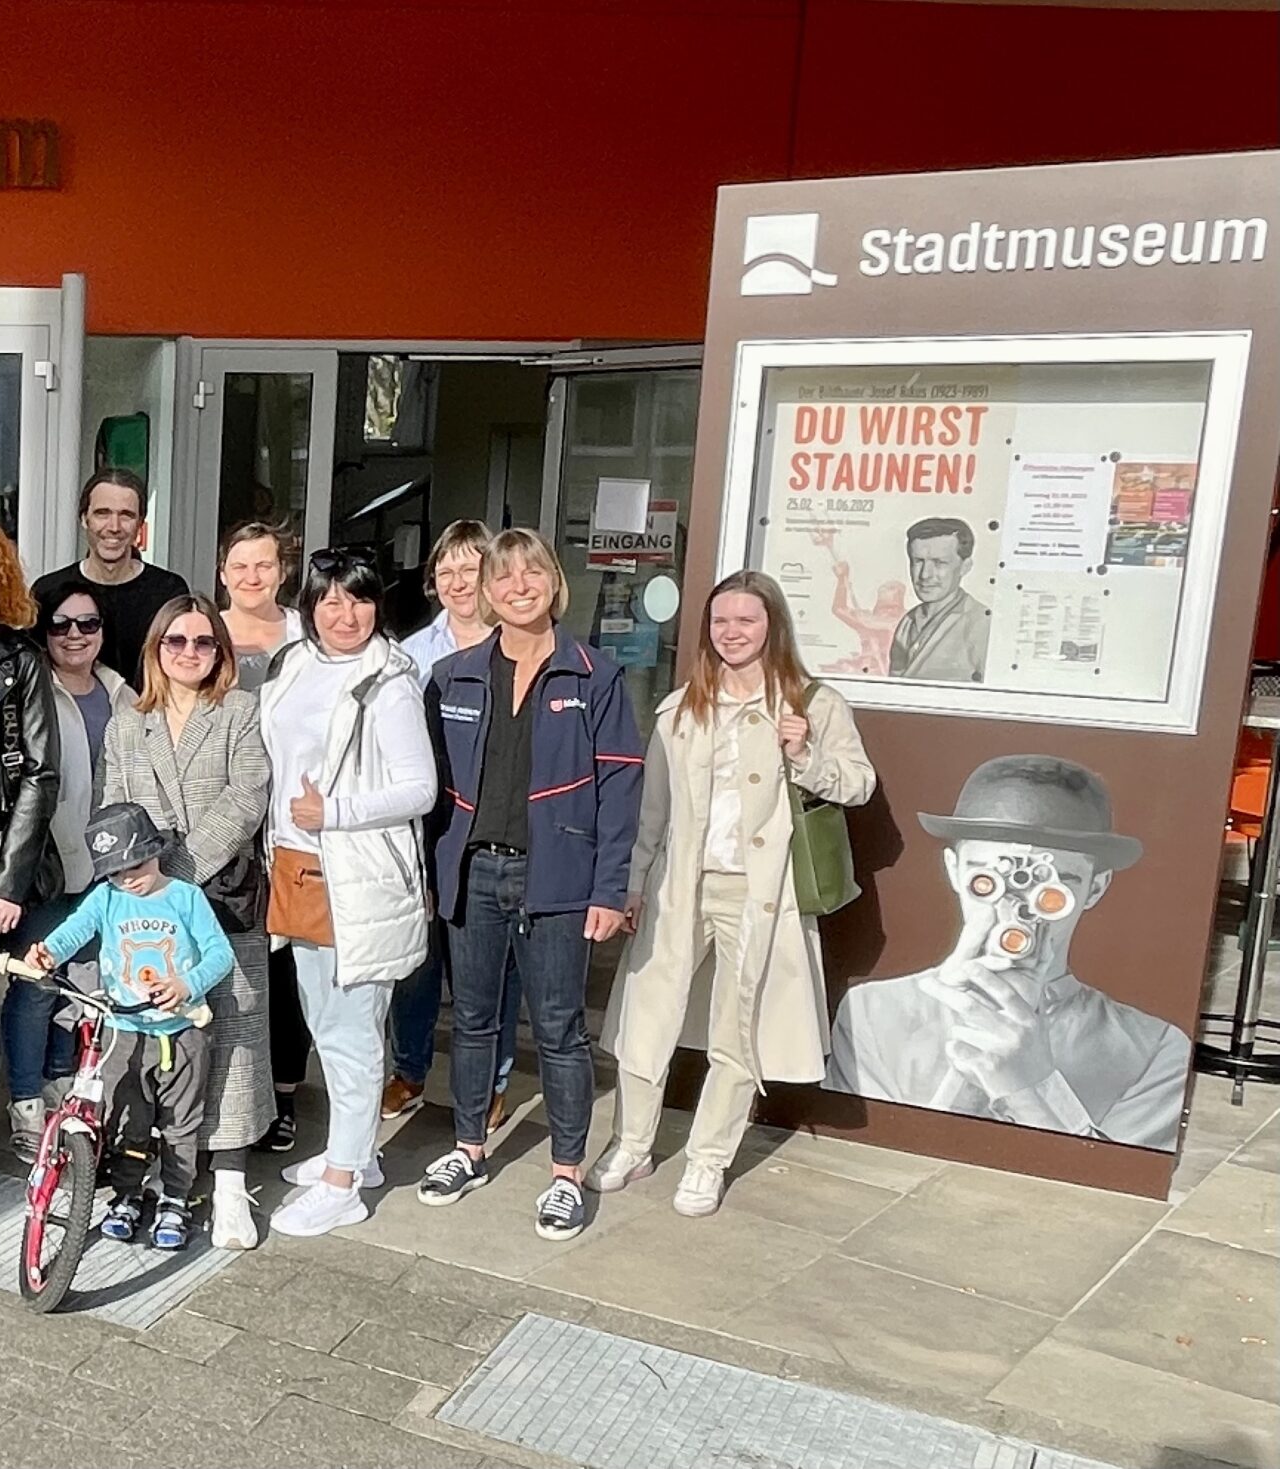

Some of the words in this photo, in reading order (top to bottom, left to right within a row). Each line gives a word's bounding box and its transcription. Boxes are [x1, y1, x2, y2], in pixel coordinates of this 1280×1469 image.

[858, 215, 1269, 278] Stadtmuseum
[794, 405, 846, 445] DU
[859, 405, 990, 447] WIRST
[789, 451, 977, 495] STAUNEN!
[591, 533, 673, 549] EINGANG
[117, 919, 179, 936] WHOOPS
